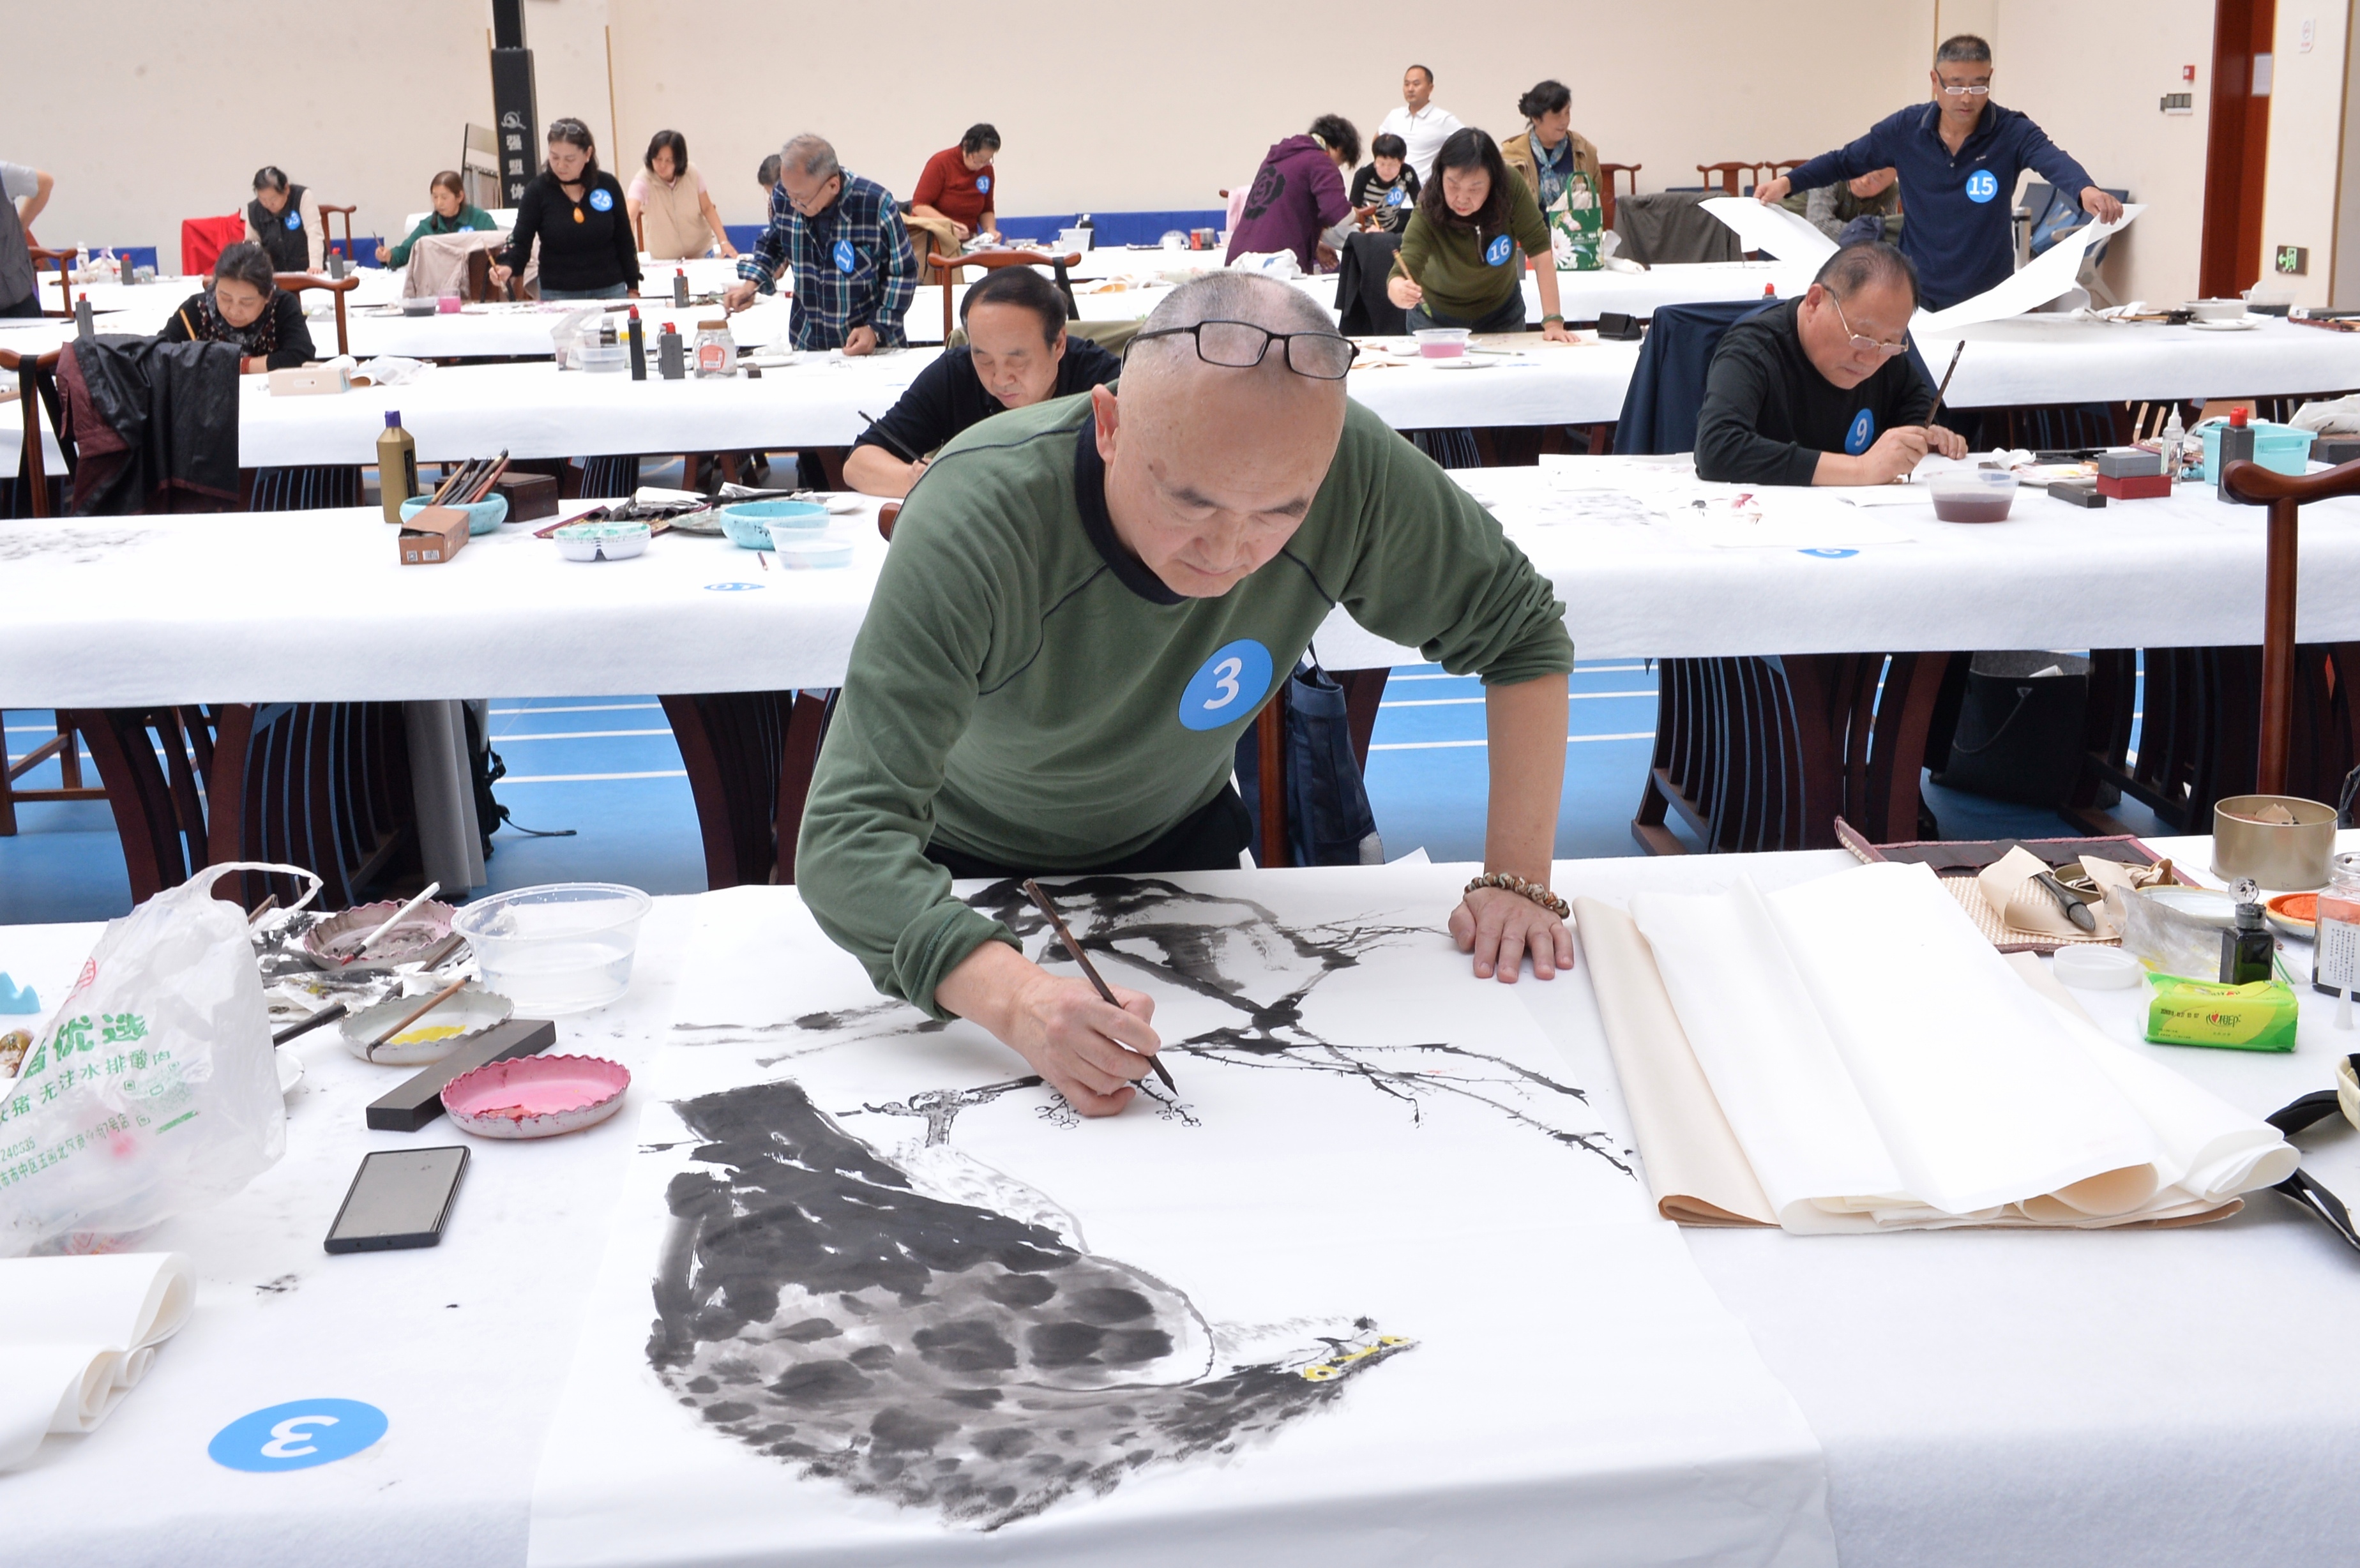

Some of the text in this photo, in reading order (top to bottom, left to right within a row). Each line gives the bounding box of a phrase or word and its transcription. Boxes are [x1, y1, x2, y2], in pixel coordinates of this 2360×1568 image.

[592, 191, 611, 207] 25
[977, 179, 989, 190] 31
[1388, 191, 1402, 202] 30
[1969, 176, 1994, 195] 15
[836, 240, 852, 269] 17
[1490, 238, 1509, 262] 16
[1855, 418, 1868, 447] 9
[1203, 657, 1242, 710] 3
[40, 1050, 170, 1104] 无注水排酸肉
[0, 1113, 130, 1190] 市市中区玉函北区商街7号店
[261, 1415, 340, 1458] 3
